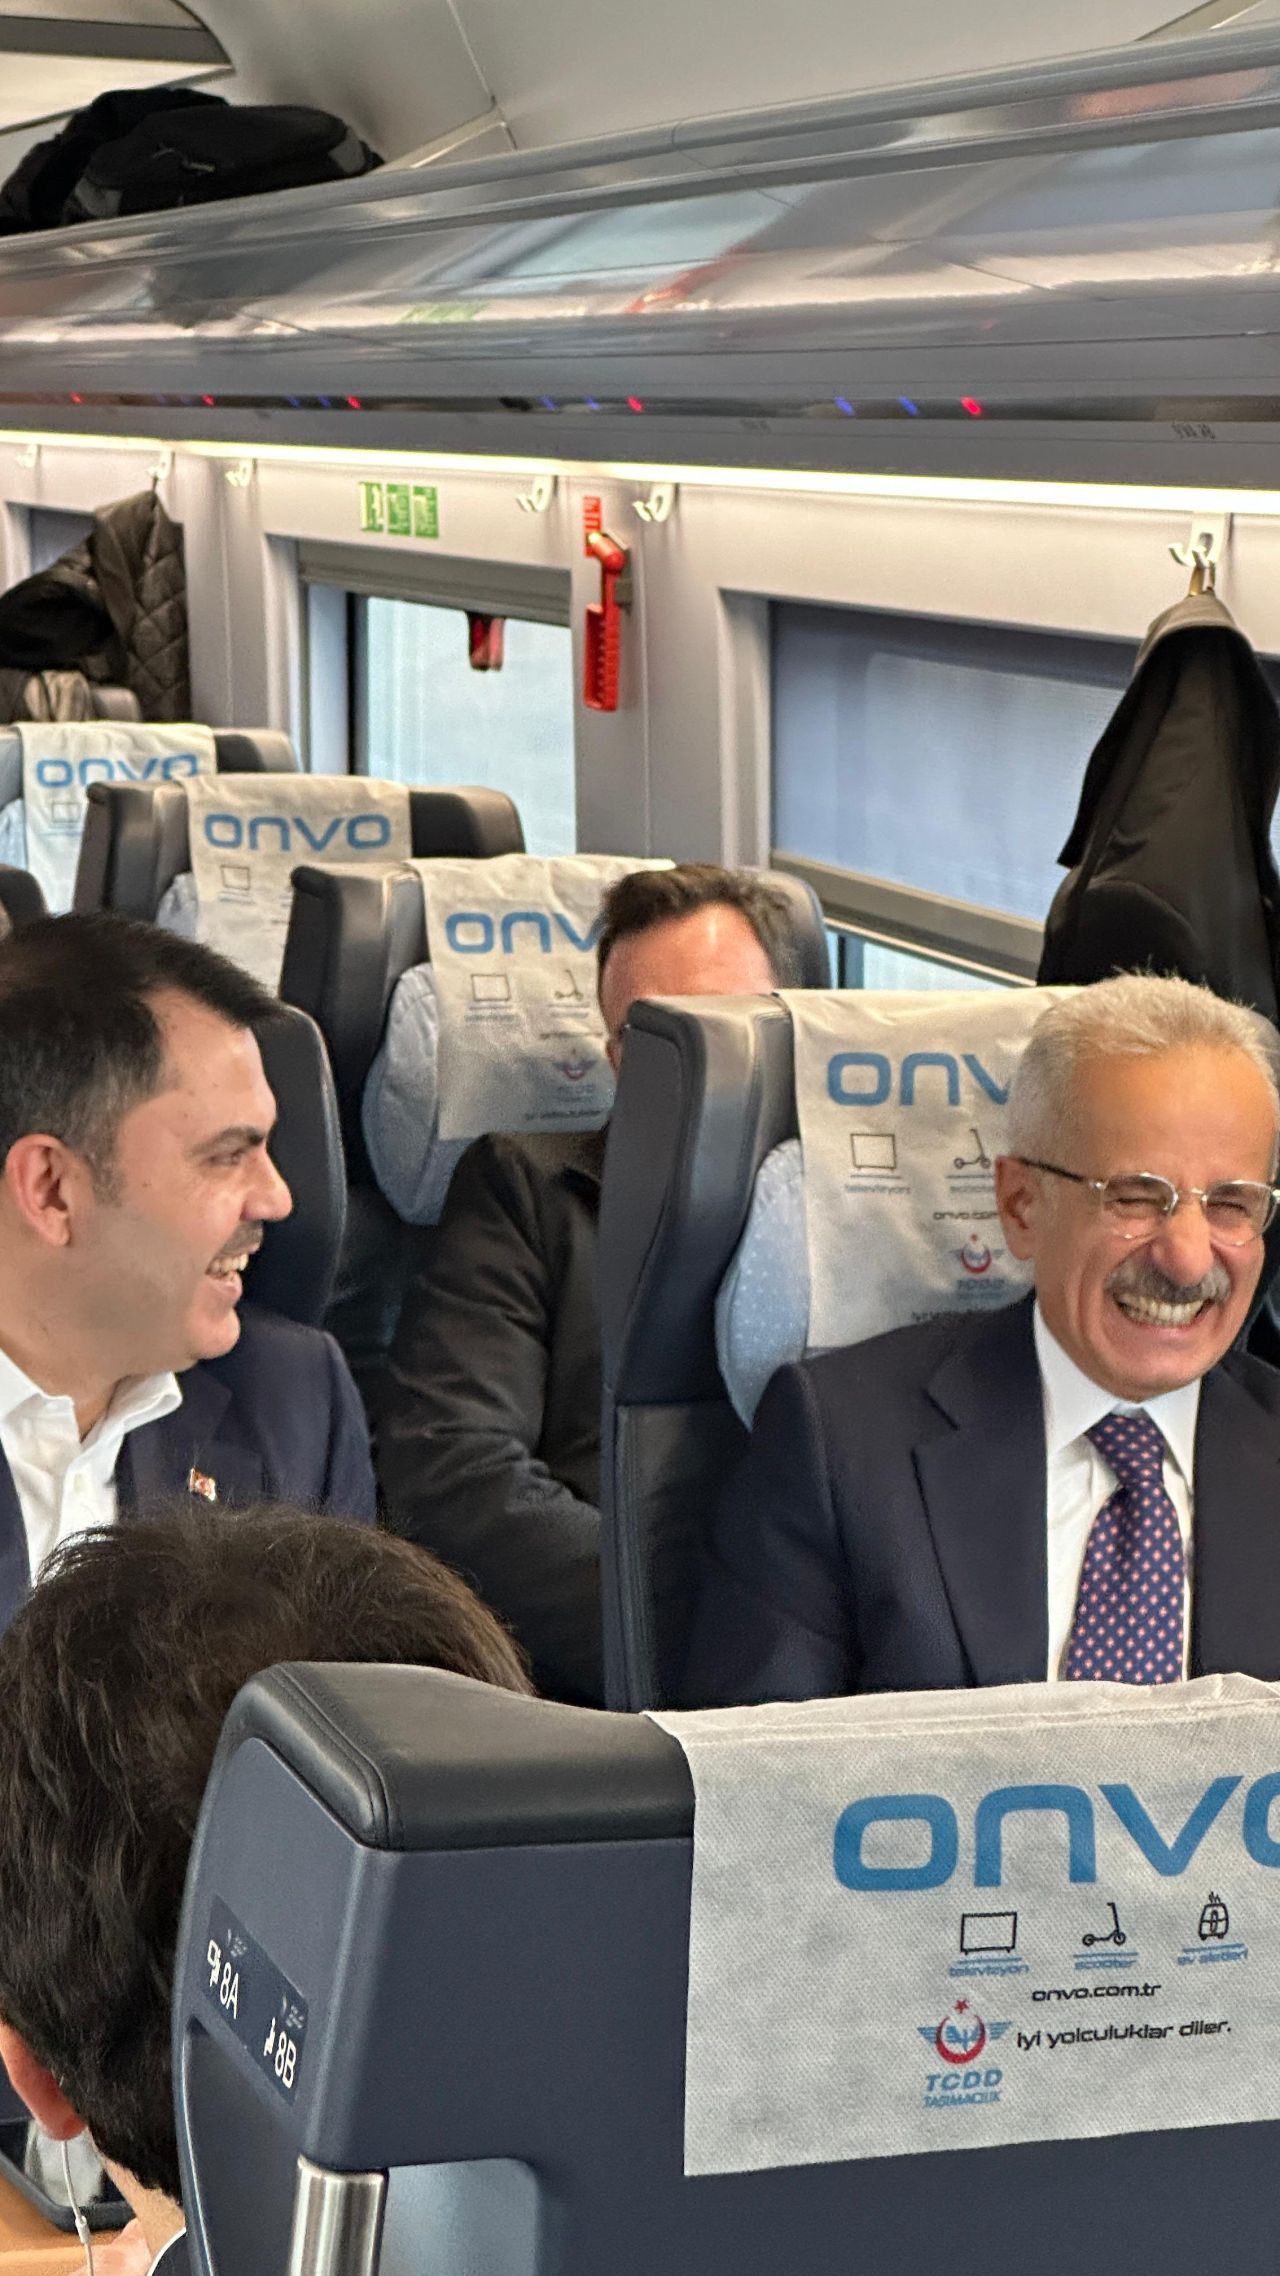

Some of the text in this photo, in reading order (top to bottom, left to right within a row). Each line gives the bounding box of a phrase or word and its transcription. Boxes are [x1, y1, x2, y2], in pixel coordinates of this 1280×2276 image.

[37, 754, 198, 788] onvo
[204, 814, 391, 852] onvo
[445, 911, 603, 954] onv
[827, 1052, 1013, 1107] onv
[220, 1962, 239, 2020] 8A
[1031, 1982, 1162, 2002] onvo.com.tr
[1047, 2024, 1174, 2049] yolculuklar
[1179, 2020, 1232, 2037] diler.
[275, 2031, 297, 2089] 8B
[926, 2069, 1003, 2092] TCDD
